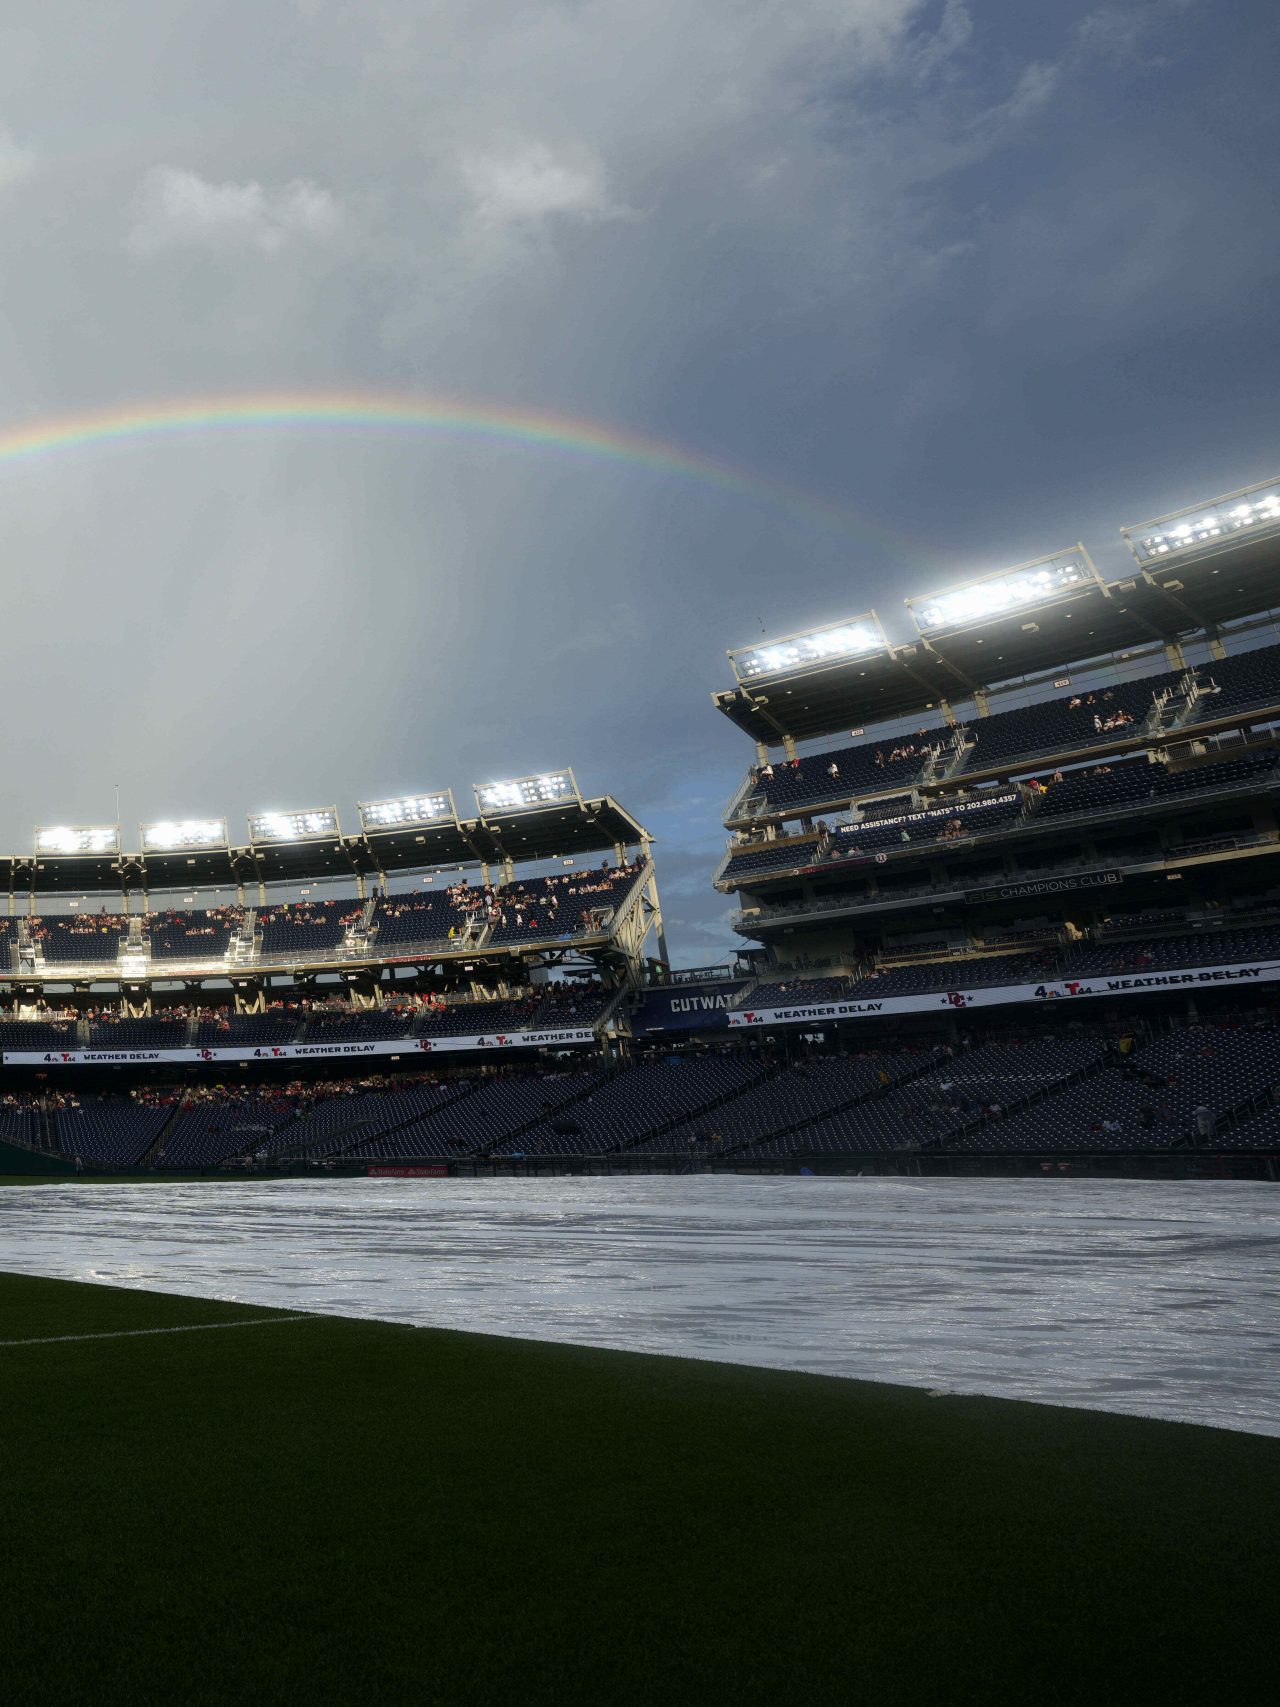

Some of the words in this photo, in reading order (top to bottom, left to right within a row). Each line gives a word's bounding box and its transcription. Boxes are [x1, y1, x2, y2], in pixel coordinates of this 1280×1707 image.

[840, 825, 859, 833] NEED
[908, 812, 926, 821] TEXT
[967, 794, 1016, 810] 202.980.4357
[1000, 879, 1076, 898] CHAMPIONS
[1080, 873, 1117, 886] CLUB
[1034, 986, 1047, 997] 4
[1108, 974, 1193, 990] WEATHER
[1198, 967, 1262, 981] DELAY
[774, 1008, 837, 1020] WEATHER
[839, 1002, 883, 1013] DELAY
[477, 1037, 486, 1046] 4
[522, 1033, 573, 1043] WEATHER
[44, 1054, 52, 1063] 4
[253, 1049, 262, 1057] 4
[343, 1044, 376, 1053] DELAY
